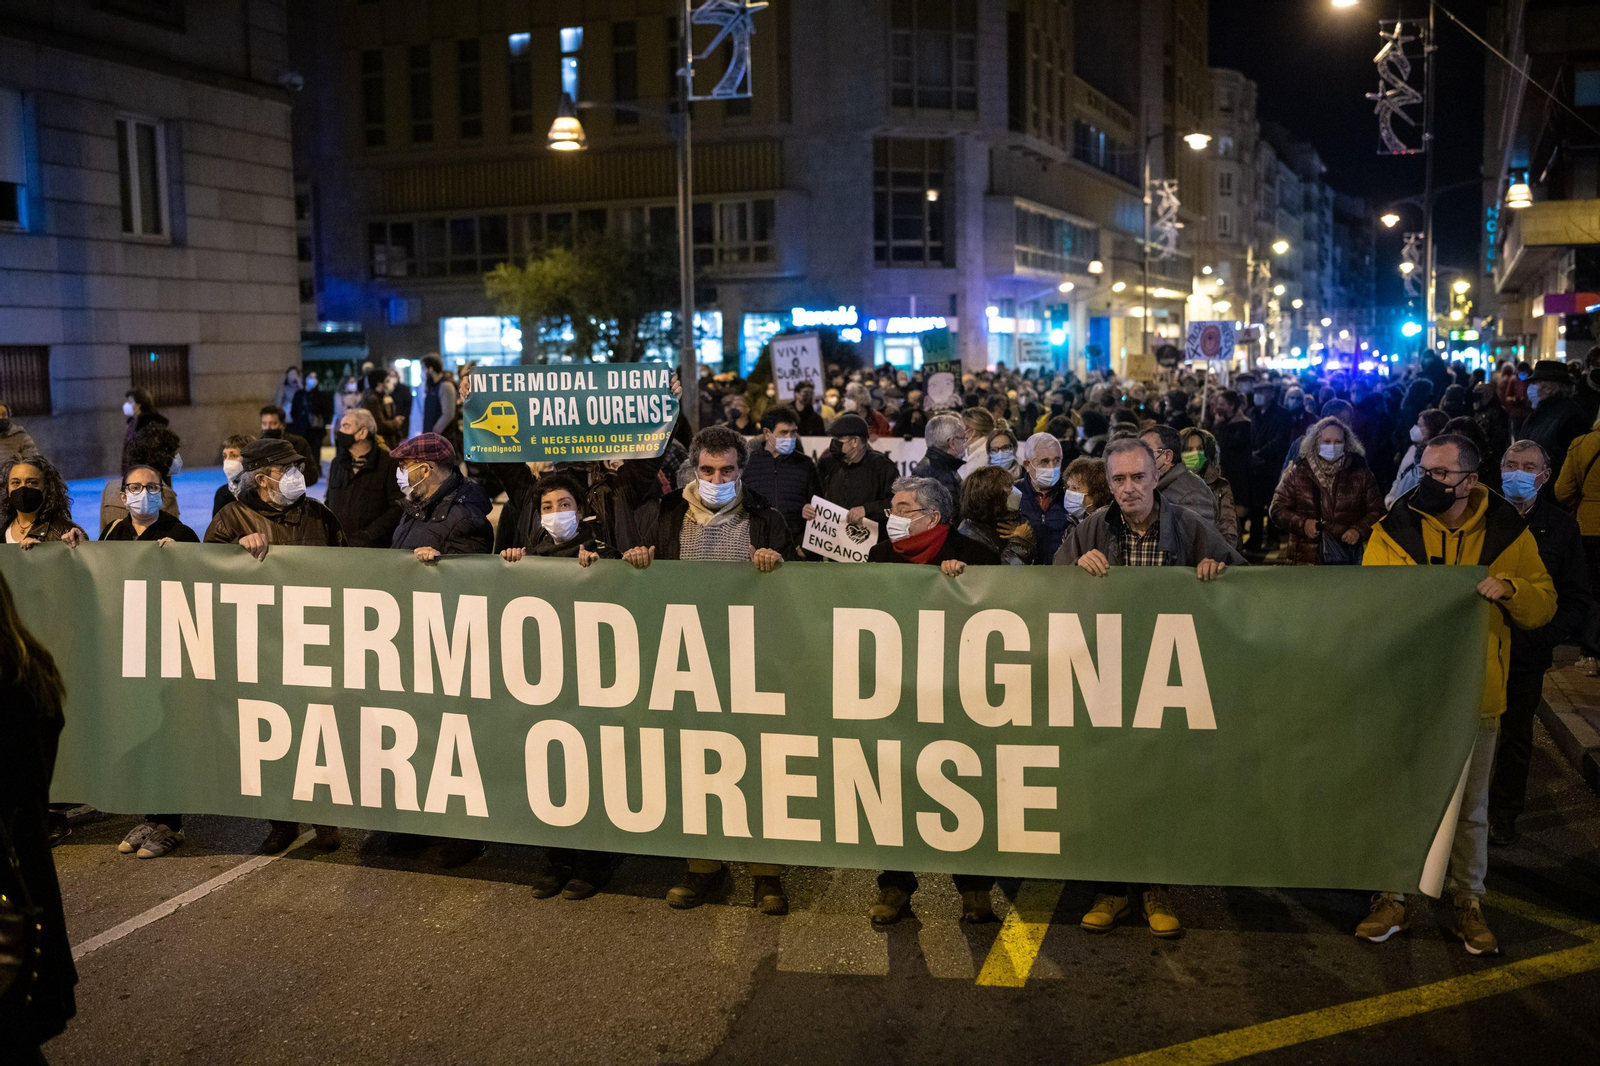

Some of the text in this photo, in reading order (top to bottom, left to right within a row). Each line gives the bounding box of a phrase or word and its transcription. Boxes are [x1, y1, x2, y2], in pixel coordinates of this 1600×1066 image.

[776, 345, 808, 358] VIVA
[791, 357, 800, 368] O
[468, 369, 670, 393] INTERMODAL DIGNA
[529, 394, 673, 427] PARA OURENSE
[530, 431, 671, 445] É NECESARIO QUE TODOS
[470, 445, 522, 454] #TrenDignoOU
[544, 443, 660, 455] NOS INVOLUCREMOS
[814, 504, 841, 525] NON
[811, 519, 837, 538] MÁIS
[122, 580, 1217, 730] INTERMODAL DIGNA
[238, 698, 1061, 855] PARA OURENSE
